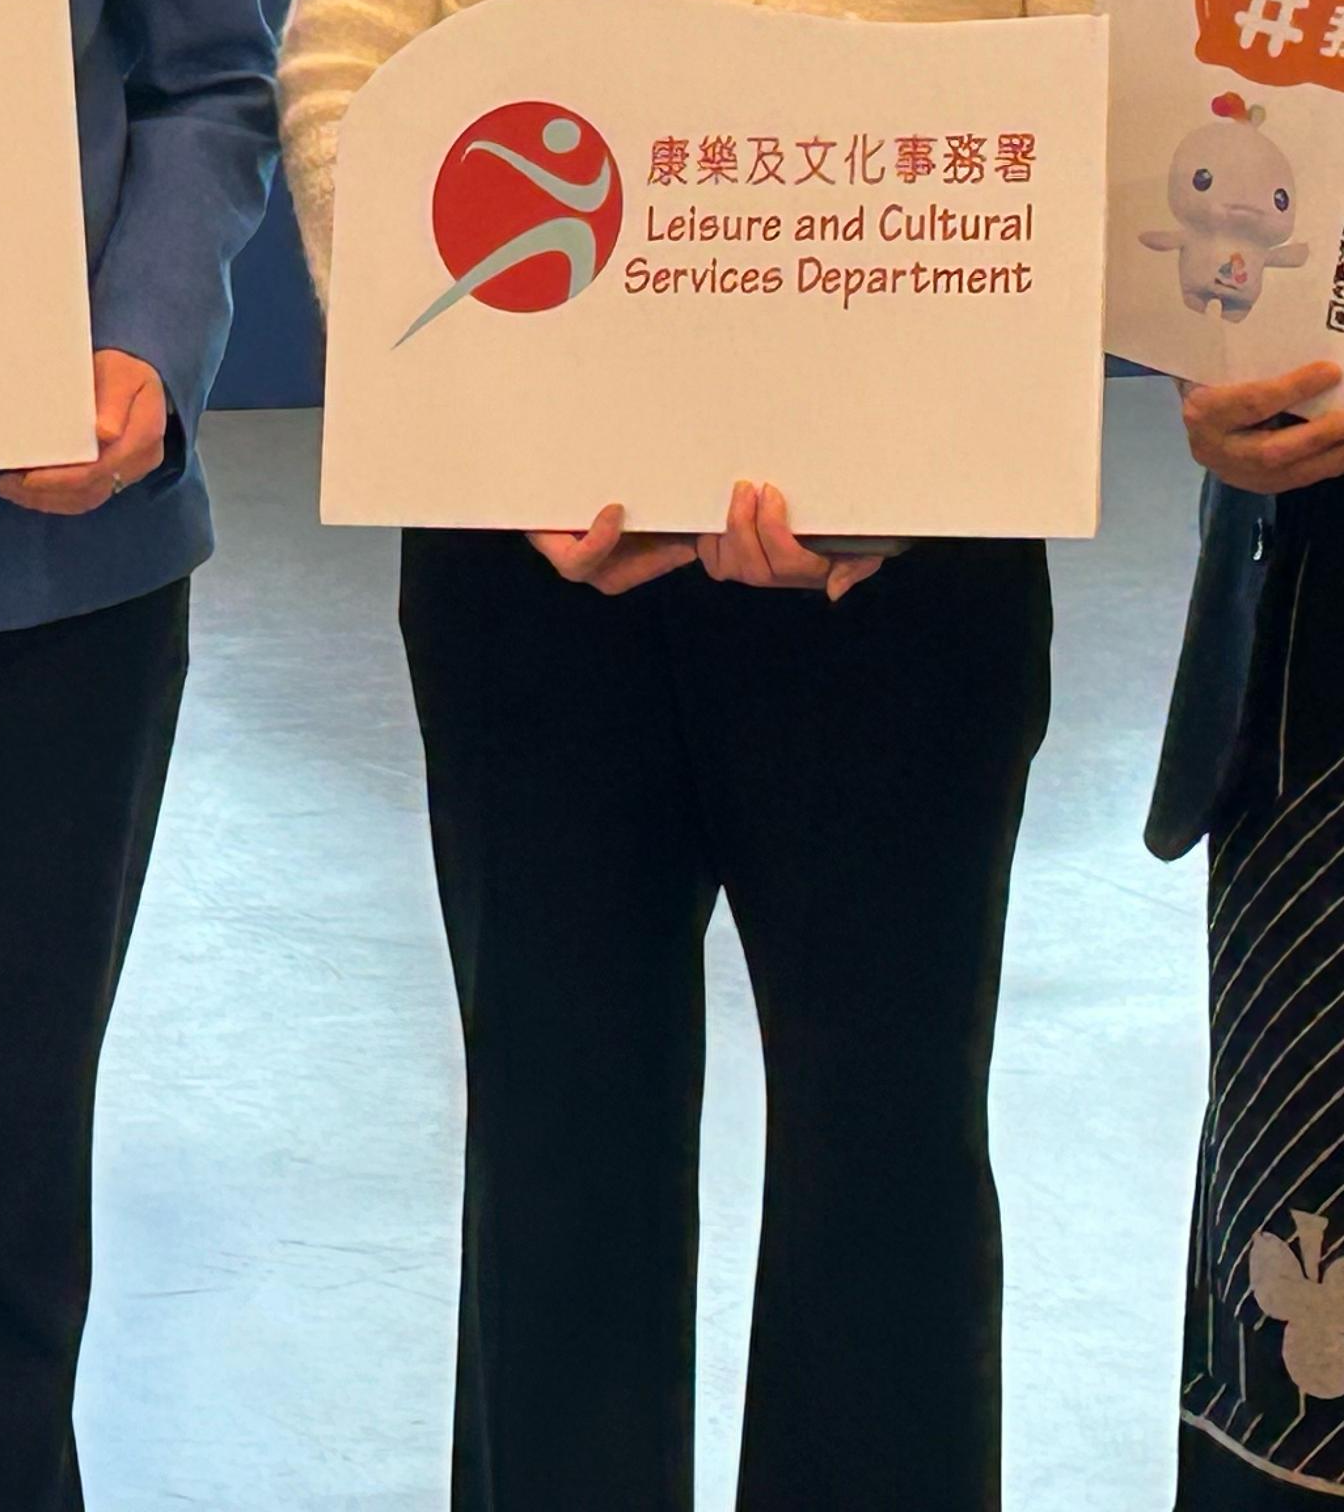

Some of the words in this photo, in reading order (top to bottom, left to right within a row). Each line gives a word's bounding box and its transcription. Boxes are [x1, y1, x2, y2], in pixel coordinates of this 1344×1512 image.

[647, 133, 1037, 186] 康樂及文化事務署
[647, 205, 781, 241] Leisure
[794, 205, 864, 241] and
[879, 203, 1033, 241] Cultural
[624, 256, 784, 294] Services
[798, 256, 1033, 310] Department
